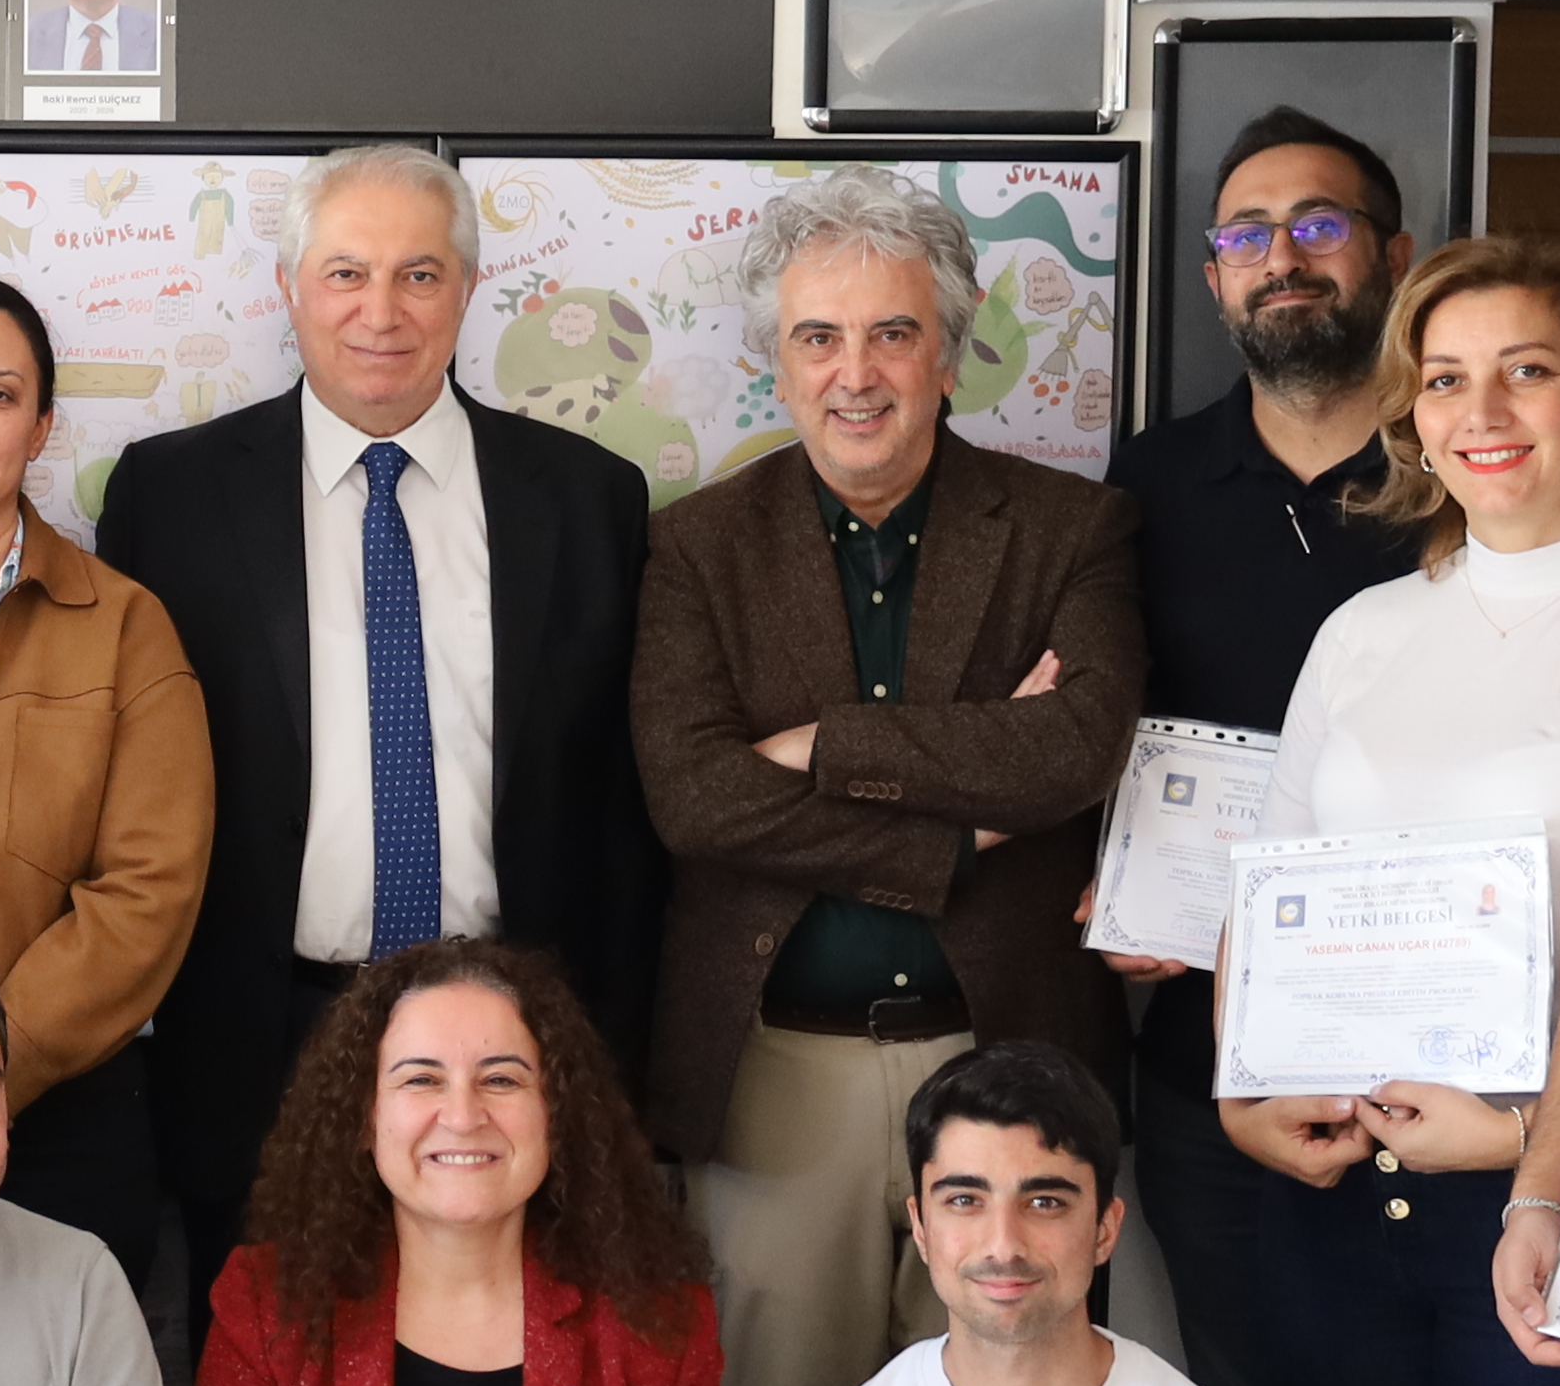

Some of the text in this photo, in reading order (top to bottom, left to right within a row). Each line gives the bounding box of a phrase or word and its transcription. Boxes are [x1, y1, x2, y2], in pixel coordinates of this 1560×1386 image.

[42, 95, 141, 107] Baki Remzi SUİÇMEZ
[497, 195, 531, 210] ZMO
[54, 223, 175, 251] ÖRGÜTLENME
[477, 234, 569, 284] ARIMSAL VERİ
[88, 263, 186, 290] KÖYDEN KENTE GÖÇ
[1326, 907, 1454, 930] YETKİ BELGESİ
[1305, 942, 1354, 957] YASEMİN
[1356, 941, 1395, 953] CANAN
[1398, 939, 1429, 953] UÇAR
